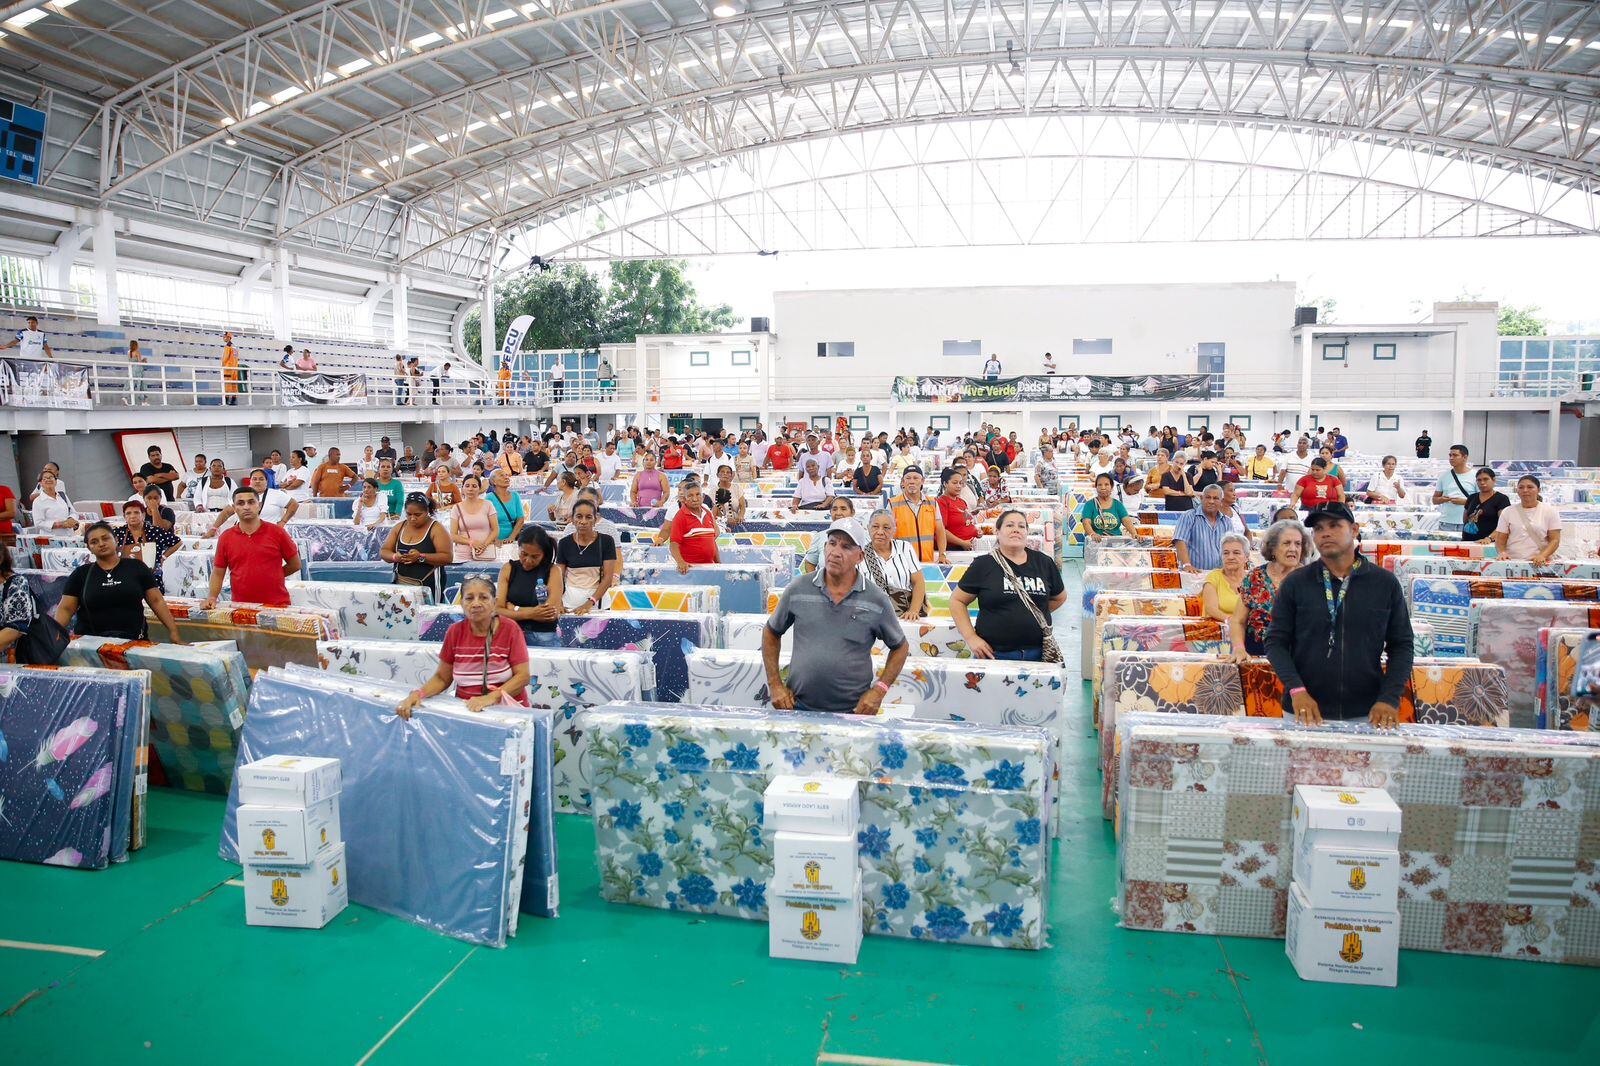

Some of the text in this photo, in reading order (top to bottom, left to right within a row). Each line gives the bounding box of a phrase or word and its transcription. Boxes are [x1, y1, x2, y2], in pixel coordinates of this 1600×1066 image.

[503, 328, 520, 370] EPCU
[961, 384, 984, 396] Vive
[986, 384, 1017, 396] Verde
[1017, 380, 1048, 392] Dadsa
